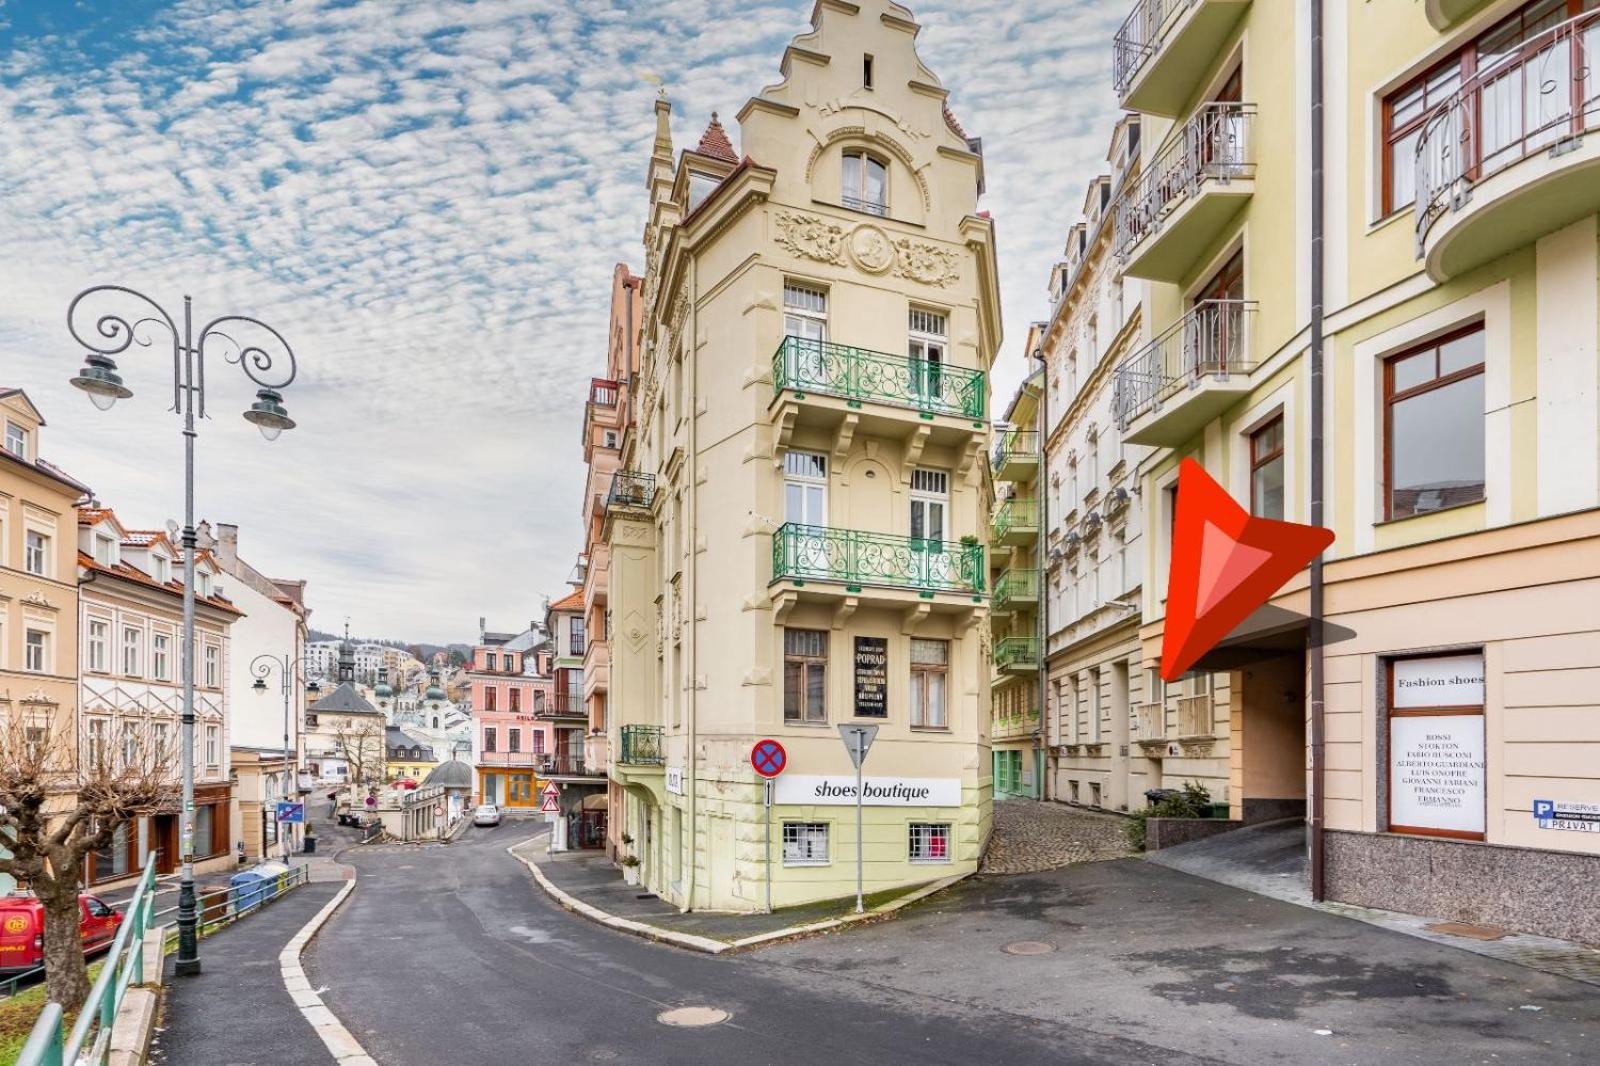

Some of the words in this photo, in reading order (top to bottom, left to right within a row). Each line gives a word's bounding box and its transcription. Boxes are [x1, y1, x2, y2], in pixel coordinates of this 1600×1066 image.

[857, 653, 885, 665] POPRAD
[1399, 677, 1445, 688] Fashion
[1448, 675, 1485, 685] shoes
[815, 781, 858, 797] shoes
[863, 782, 929, 801] boutique
[1553, 820, 1594, 831] PRIVAT
